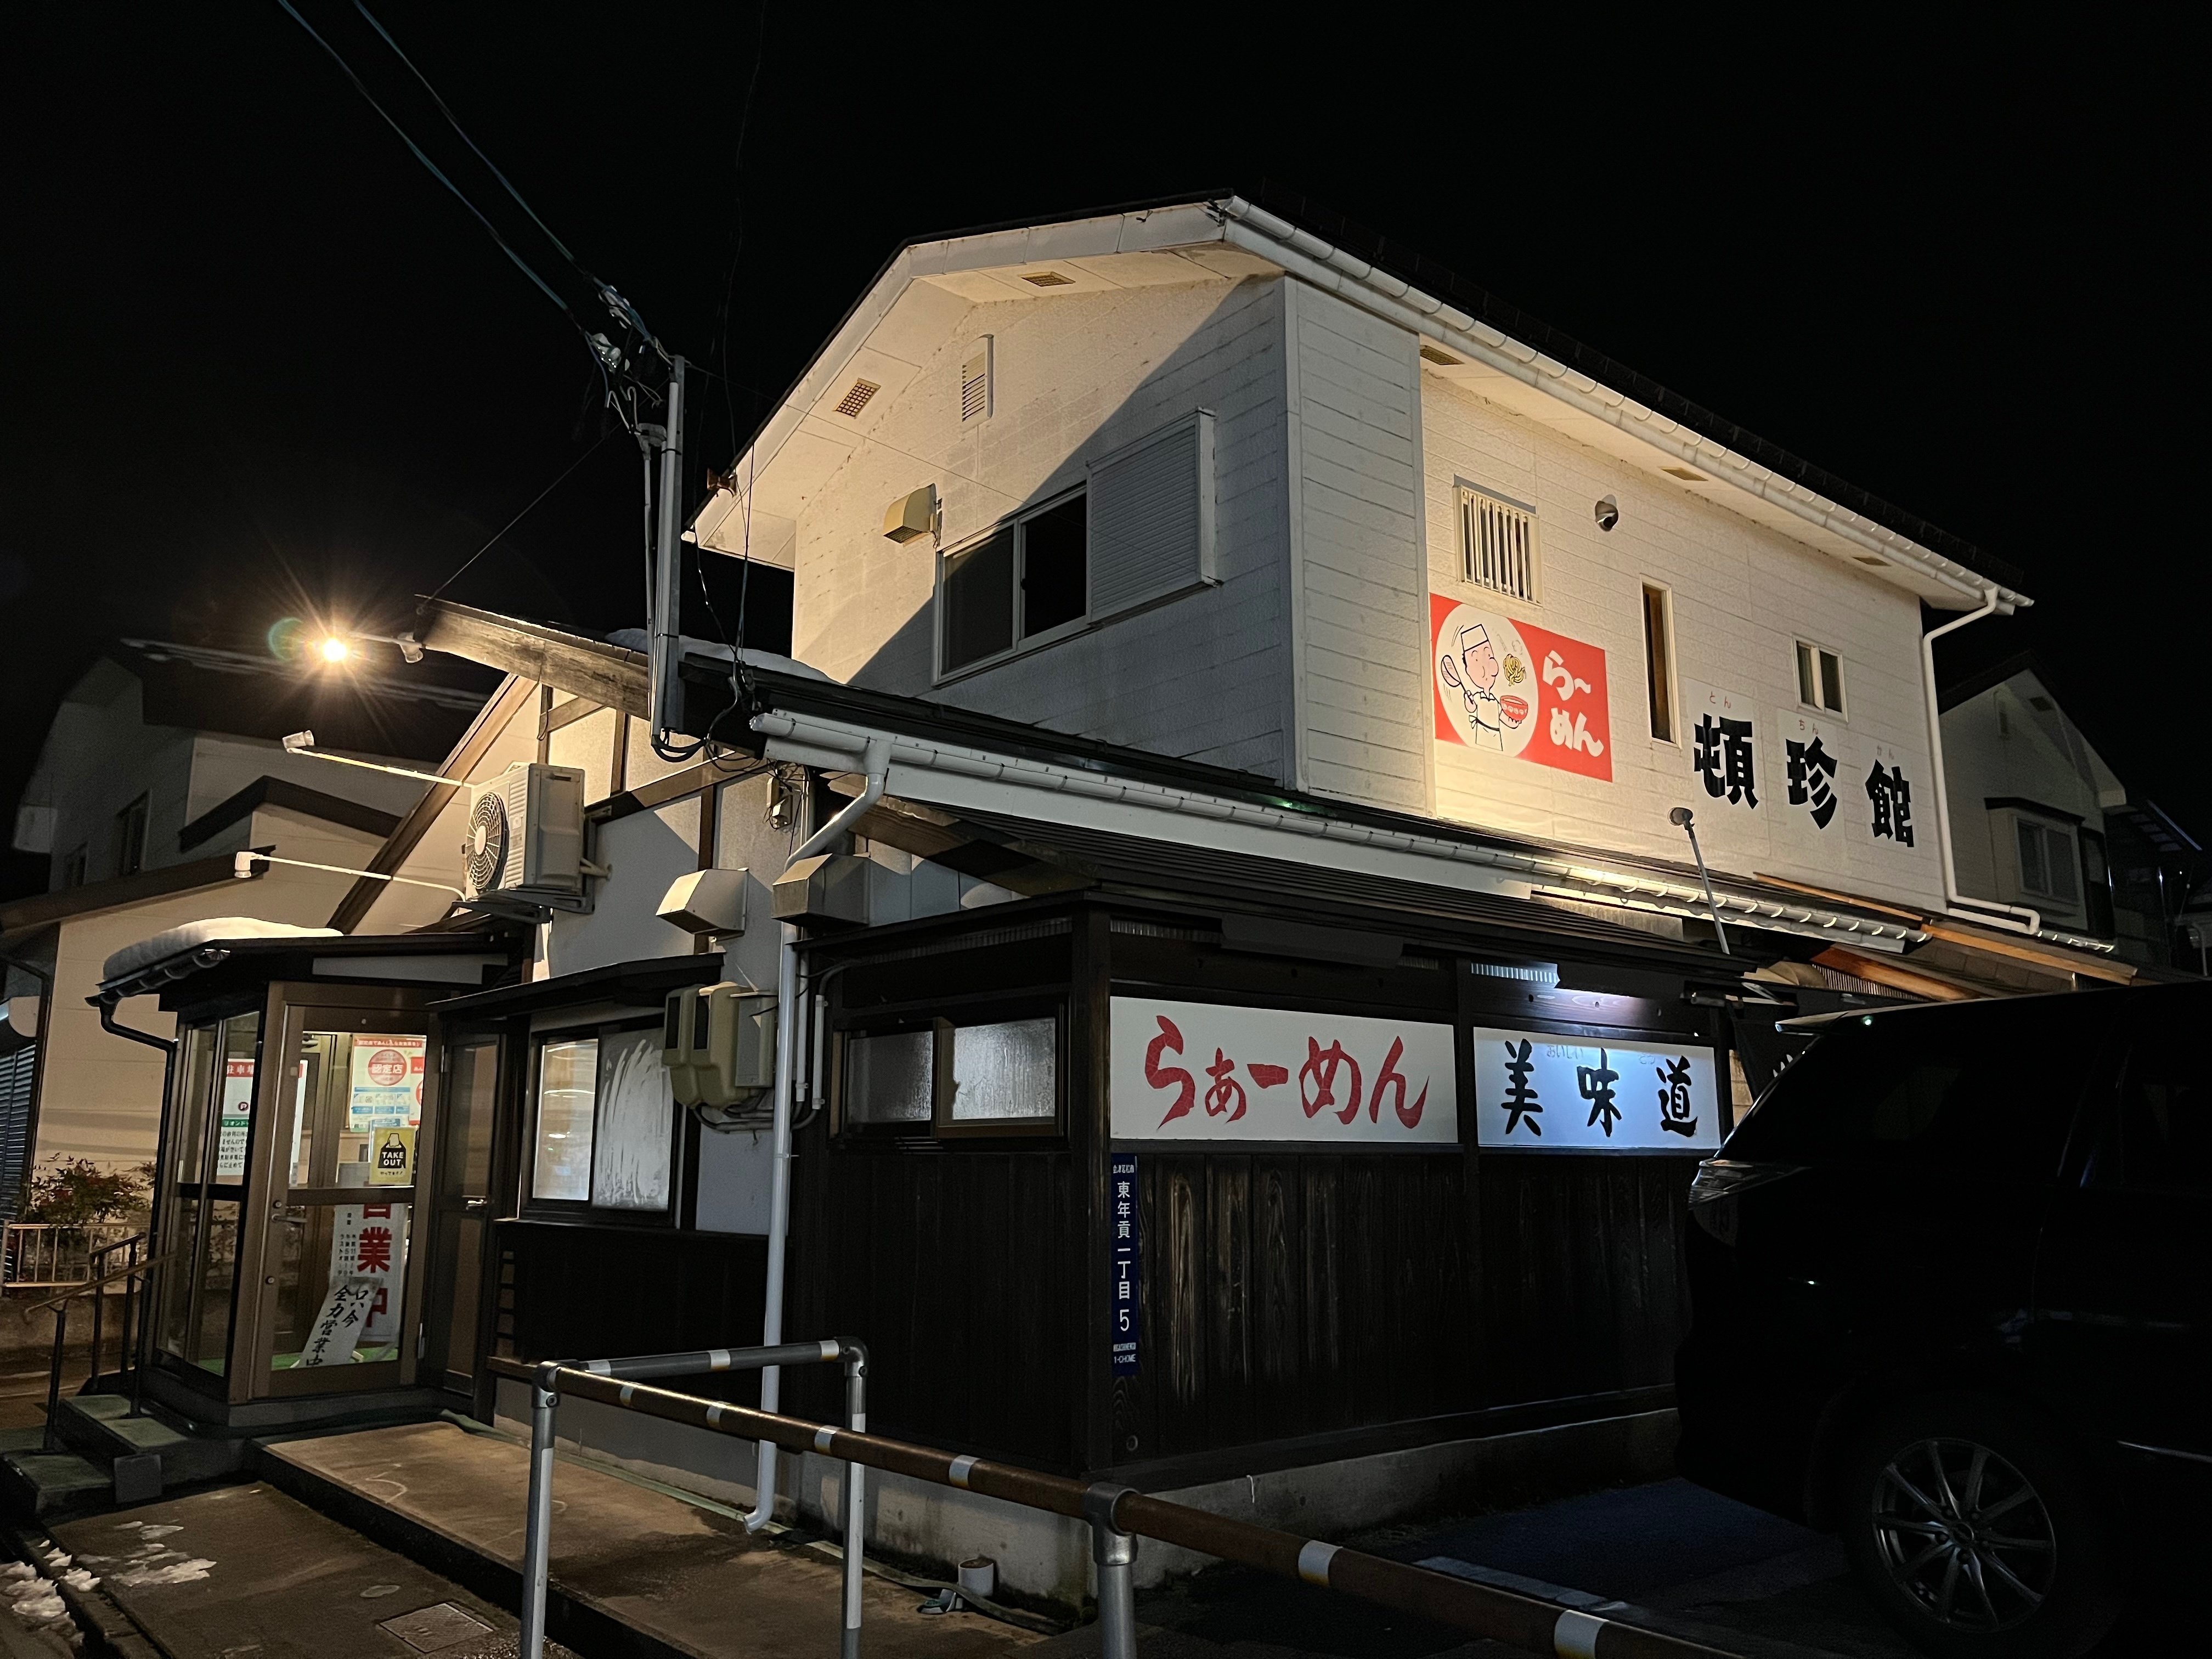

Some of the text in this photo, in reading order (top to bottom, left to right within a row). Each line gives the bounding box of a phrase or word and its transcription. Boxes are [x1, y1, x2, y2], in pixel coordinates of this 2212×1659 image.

[1550, 707, 1604, 757] めん
[1709, 691, 1732, 709] とん
[1799, 719, 1819, 736] ちん
[1694, 713, 1915, 848] 頓珍館
[371, 1064, 403, 1074] 認定店
[1503, 1038, 1699, 1138] 美味道
[1117, 1181, 1131, 1300] 東年貢一丁目
[306, 1284, 357, 1366] 全力営業中
[342, 1290, 369, 1328] 只今
[1120, 1309, 1130, 1331] 5
